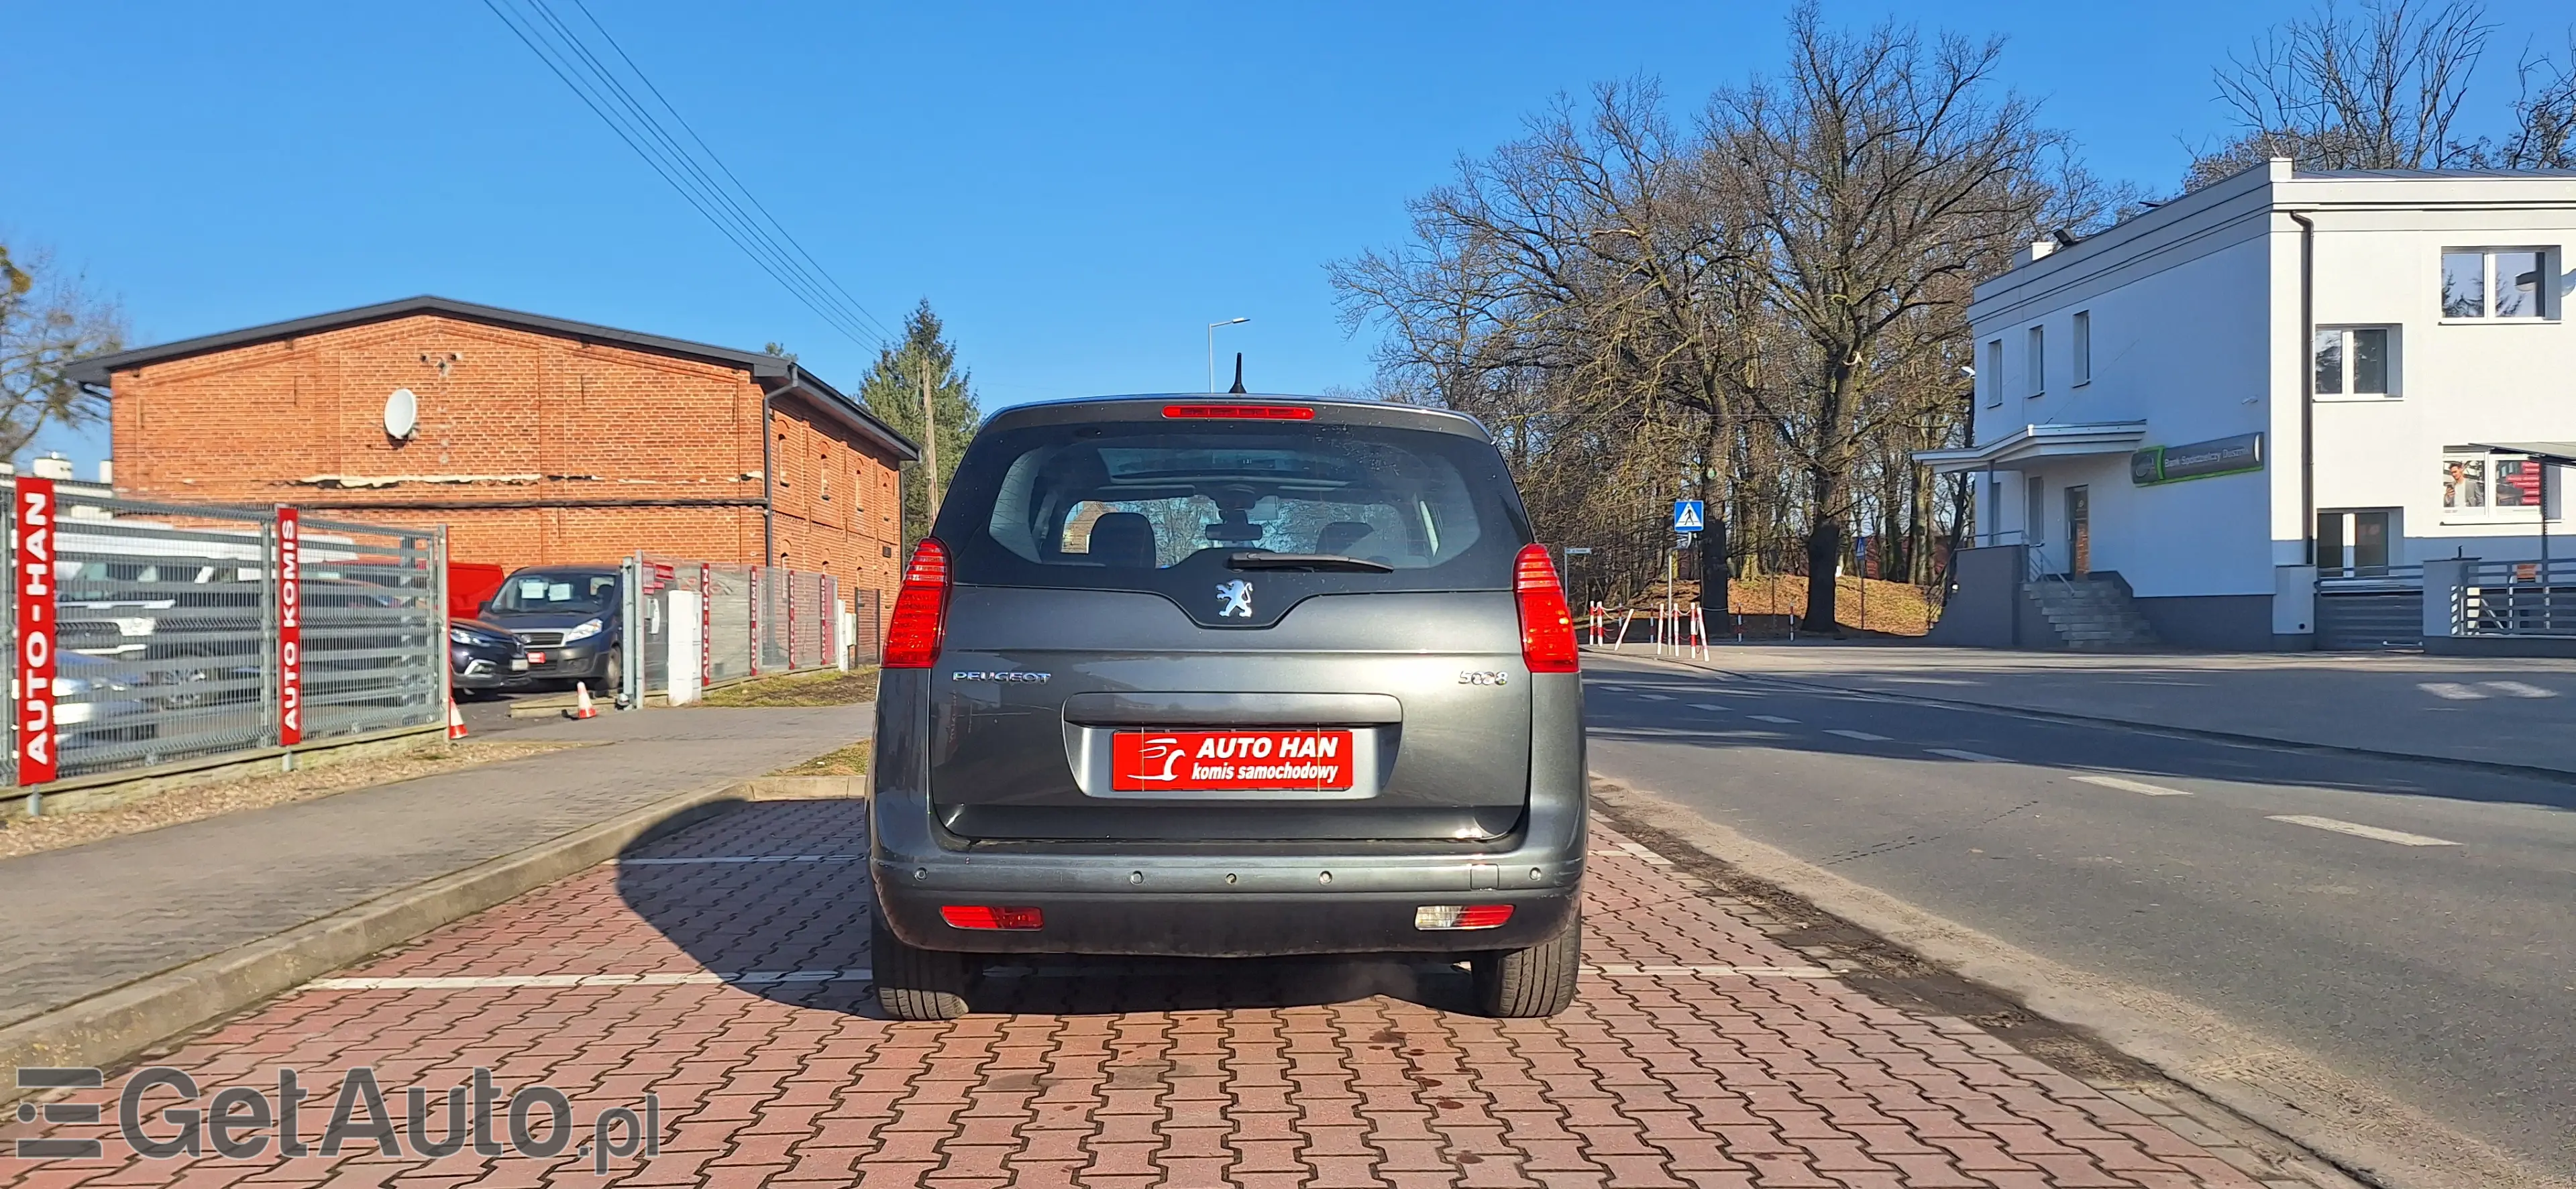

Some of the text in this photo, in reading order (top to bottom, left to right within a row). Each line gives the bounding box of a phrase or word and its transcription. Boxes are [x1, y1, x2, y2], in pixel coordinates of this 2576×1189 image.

[24, 492, 48, 596] HAN
[282, 519, 298, 730] AUTO KOMIS
[953, 671, 1051, 684] PEUGEOT
[1458, 671, 1508, 685] 5008
[26, 630, 48, 765] AUTO
[1195, 736, 1338, 758] AUTO HAN
[1191, 762, 1338, 783] komis samochodowy
